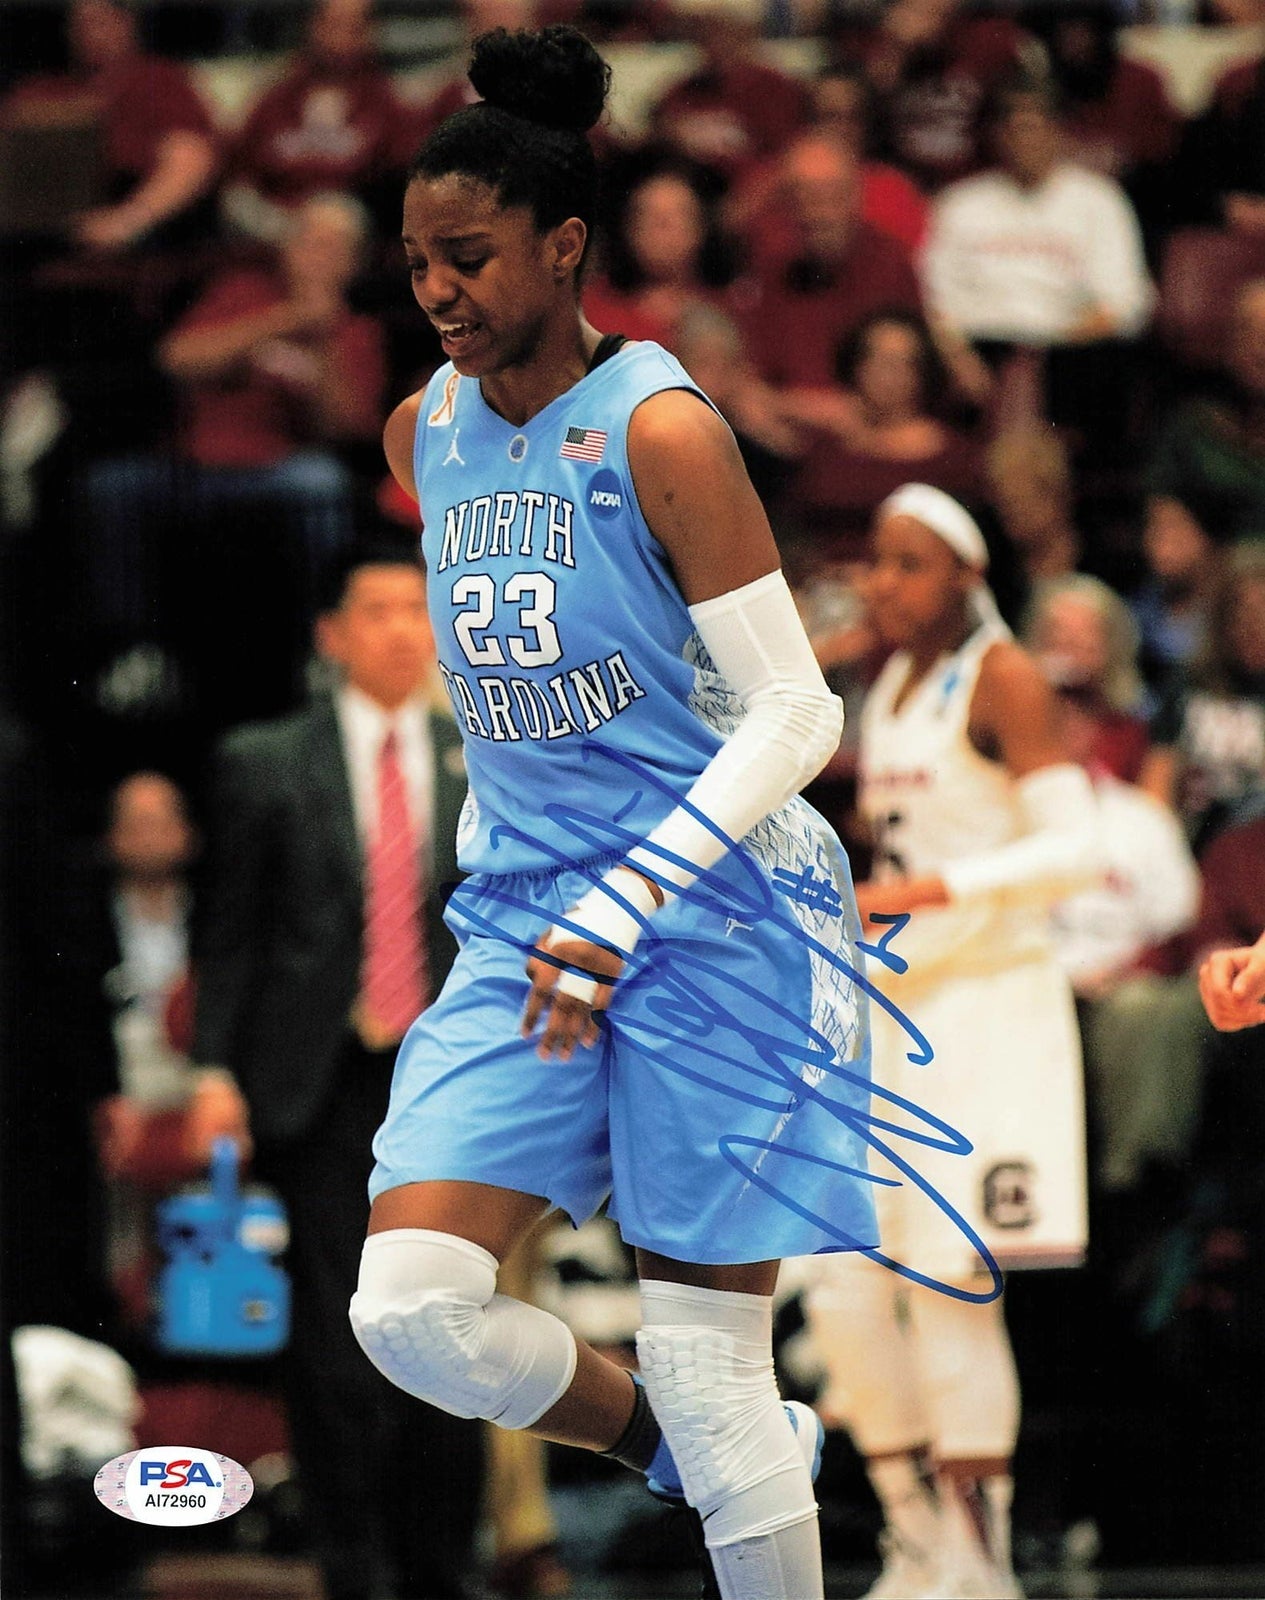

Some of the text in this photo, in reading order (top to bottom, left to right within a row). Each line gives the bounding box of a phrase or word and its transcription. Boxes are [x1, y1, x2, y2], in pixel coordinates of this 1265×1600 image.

[437, 490, 577, 573] NORTH
[590, 490, 622, 508] NCAA
[451, 571, 563, 669] 23
